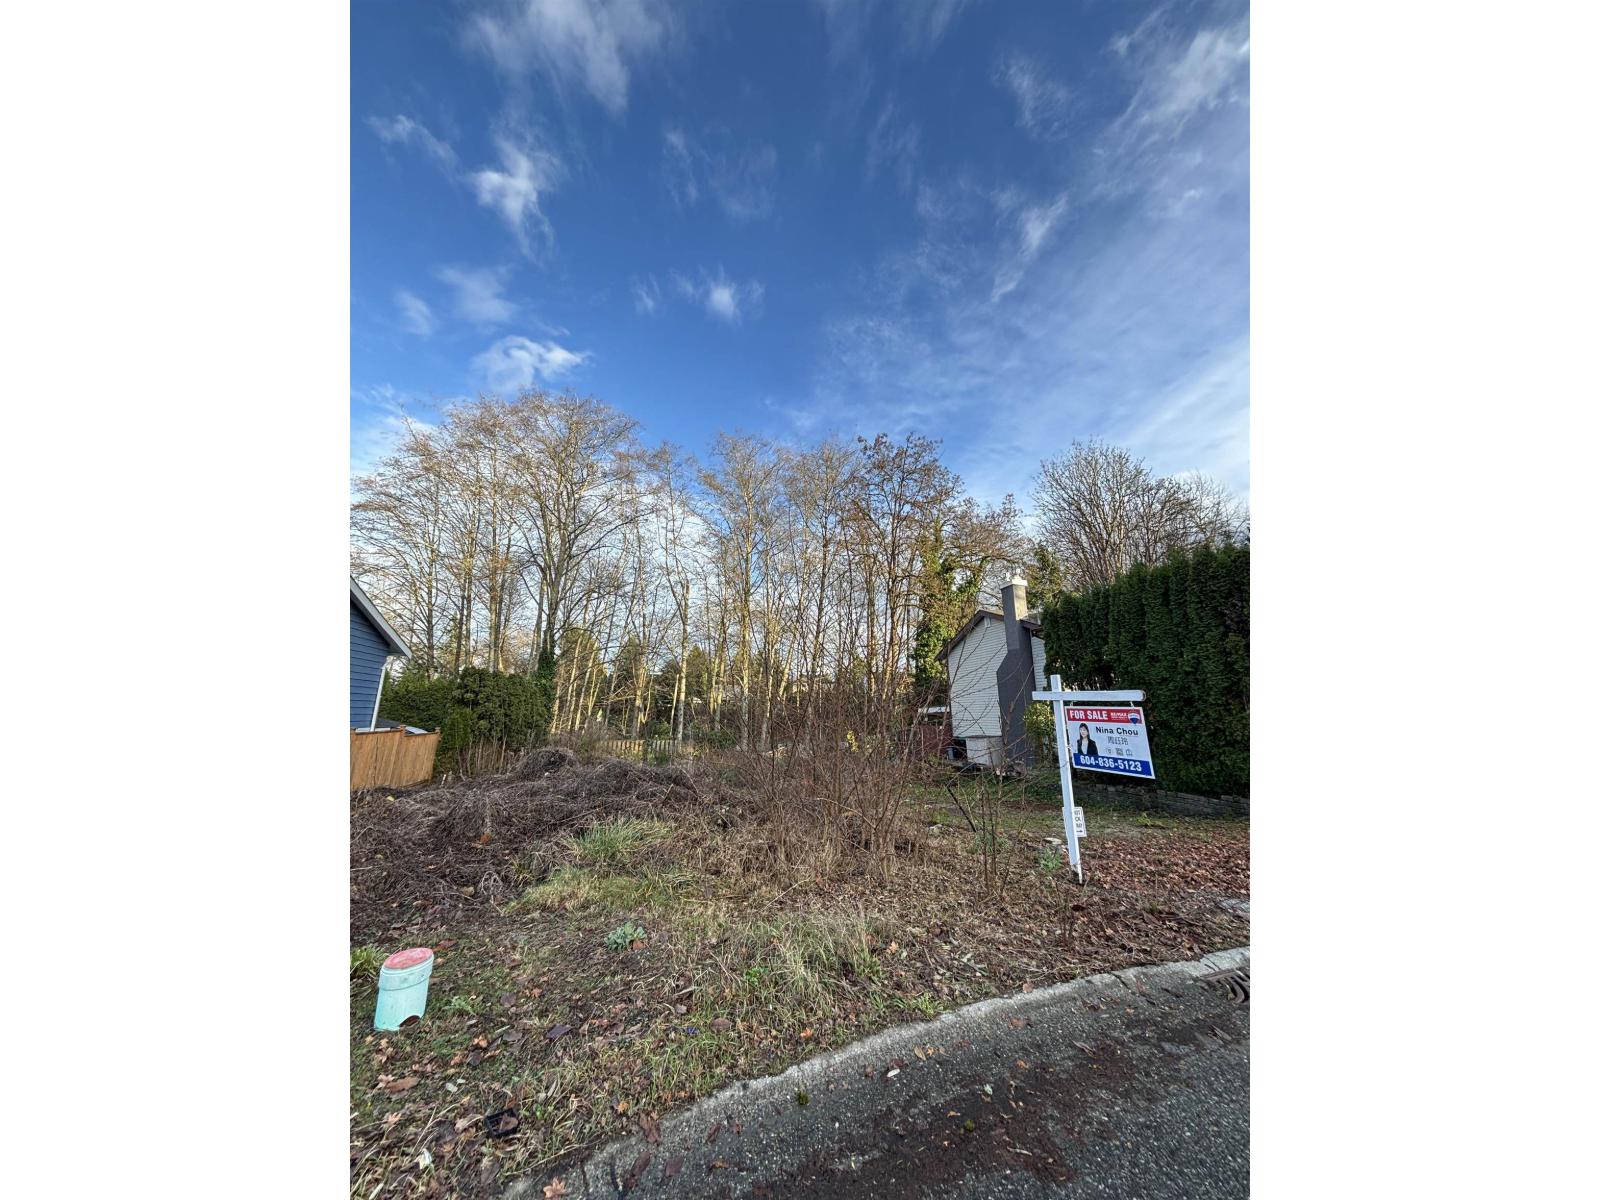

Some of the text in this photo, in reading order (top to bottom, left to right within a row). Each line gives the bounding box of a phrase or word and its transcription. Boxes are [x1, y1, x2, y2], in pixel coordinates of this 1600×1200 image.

[1070, 710, 1108, 720] FOR SALE
[1095, 726, 1138, 736] Nina Chou
[1080, 755, 1142, 772] 604-836-5123
